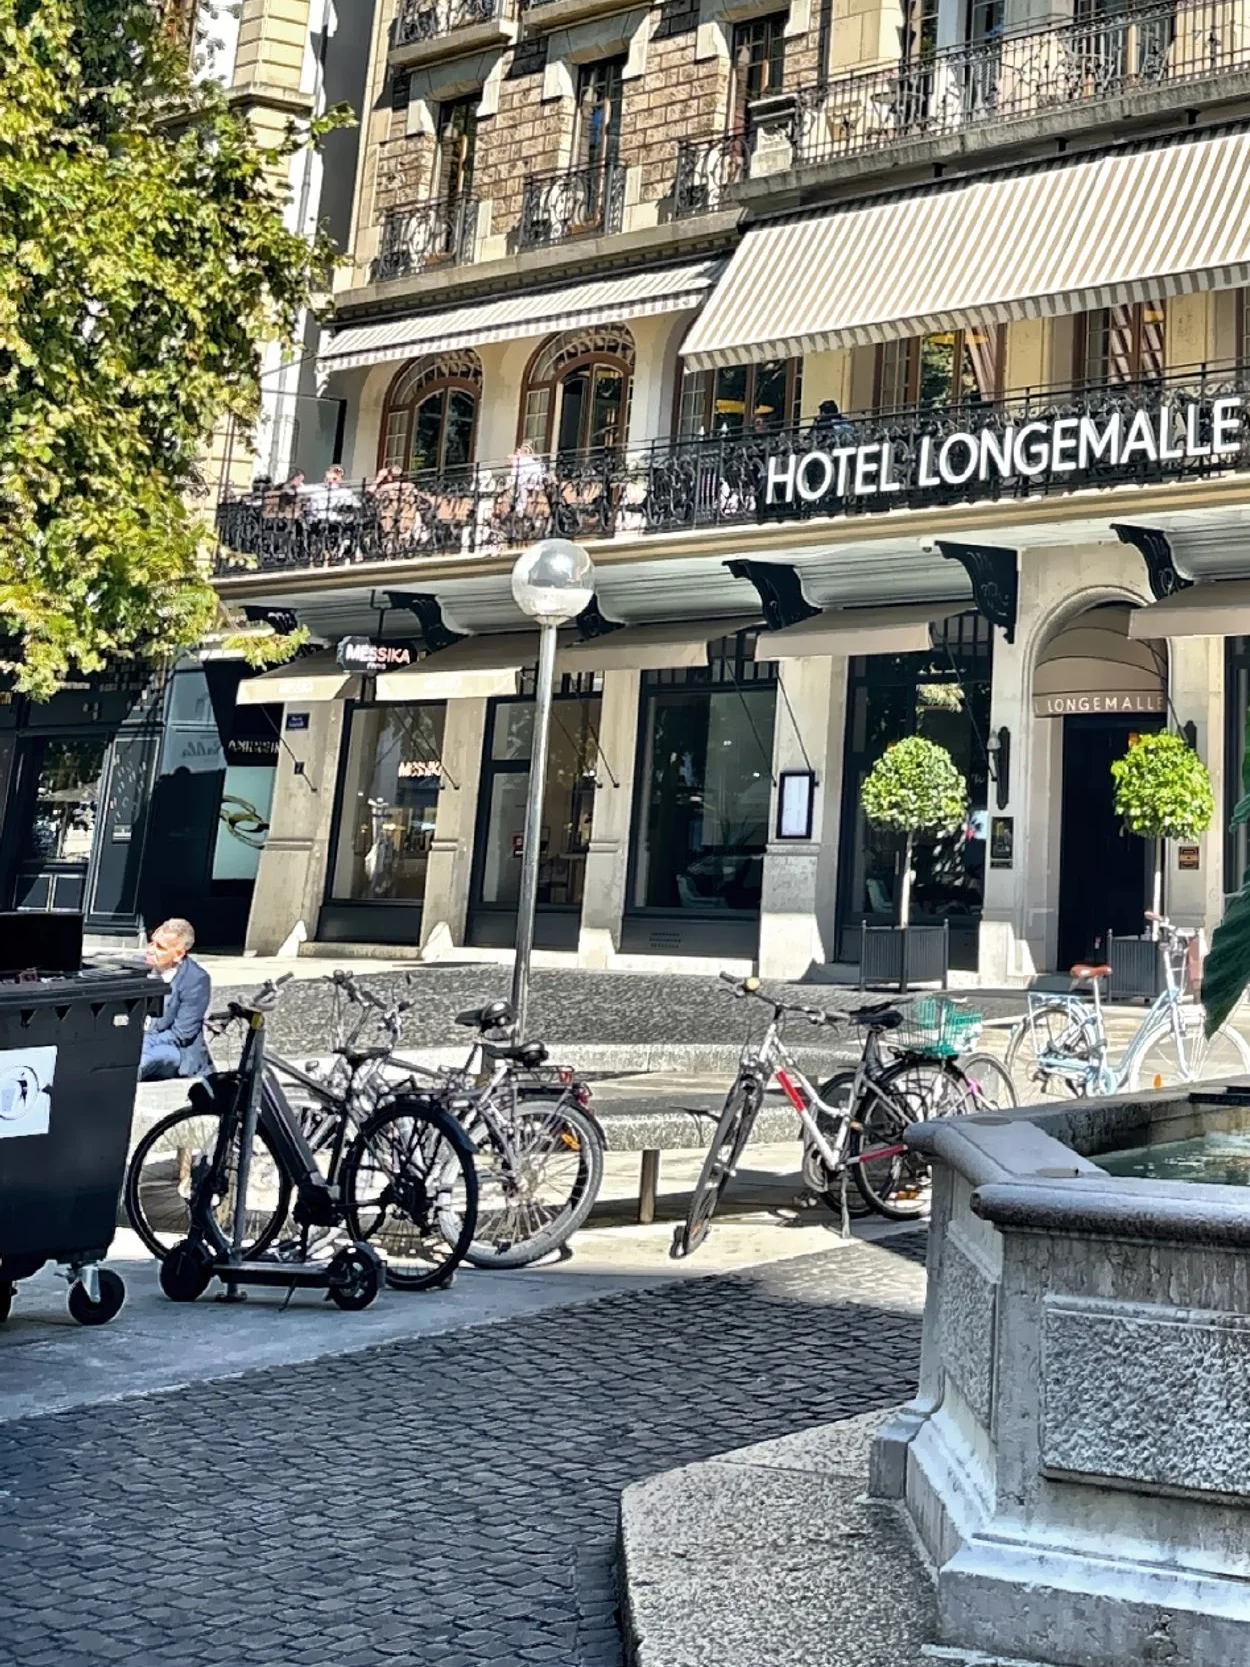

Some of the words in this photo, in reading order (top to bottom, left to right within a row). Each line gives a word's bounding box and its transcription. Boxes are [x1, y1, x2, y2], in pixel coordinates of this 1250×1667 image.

[765, 443, 901, 505] HOTEL
[917, 397, 1243, 486] LONGEMALLE
[345, 643, 410, 664] MESSIKA
[1047, 696, 1164, 713] LONGEMALLE
